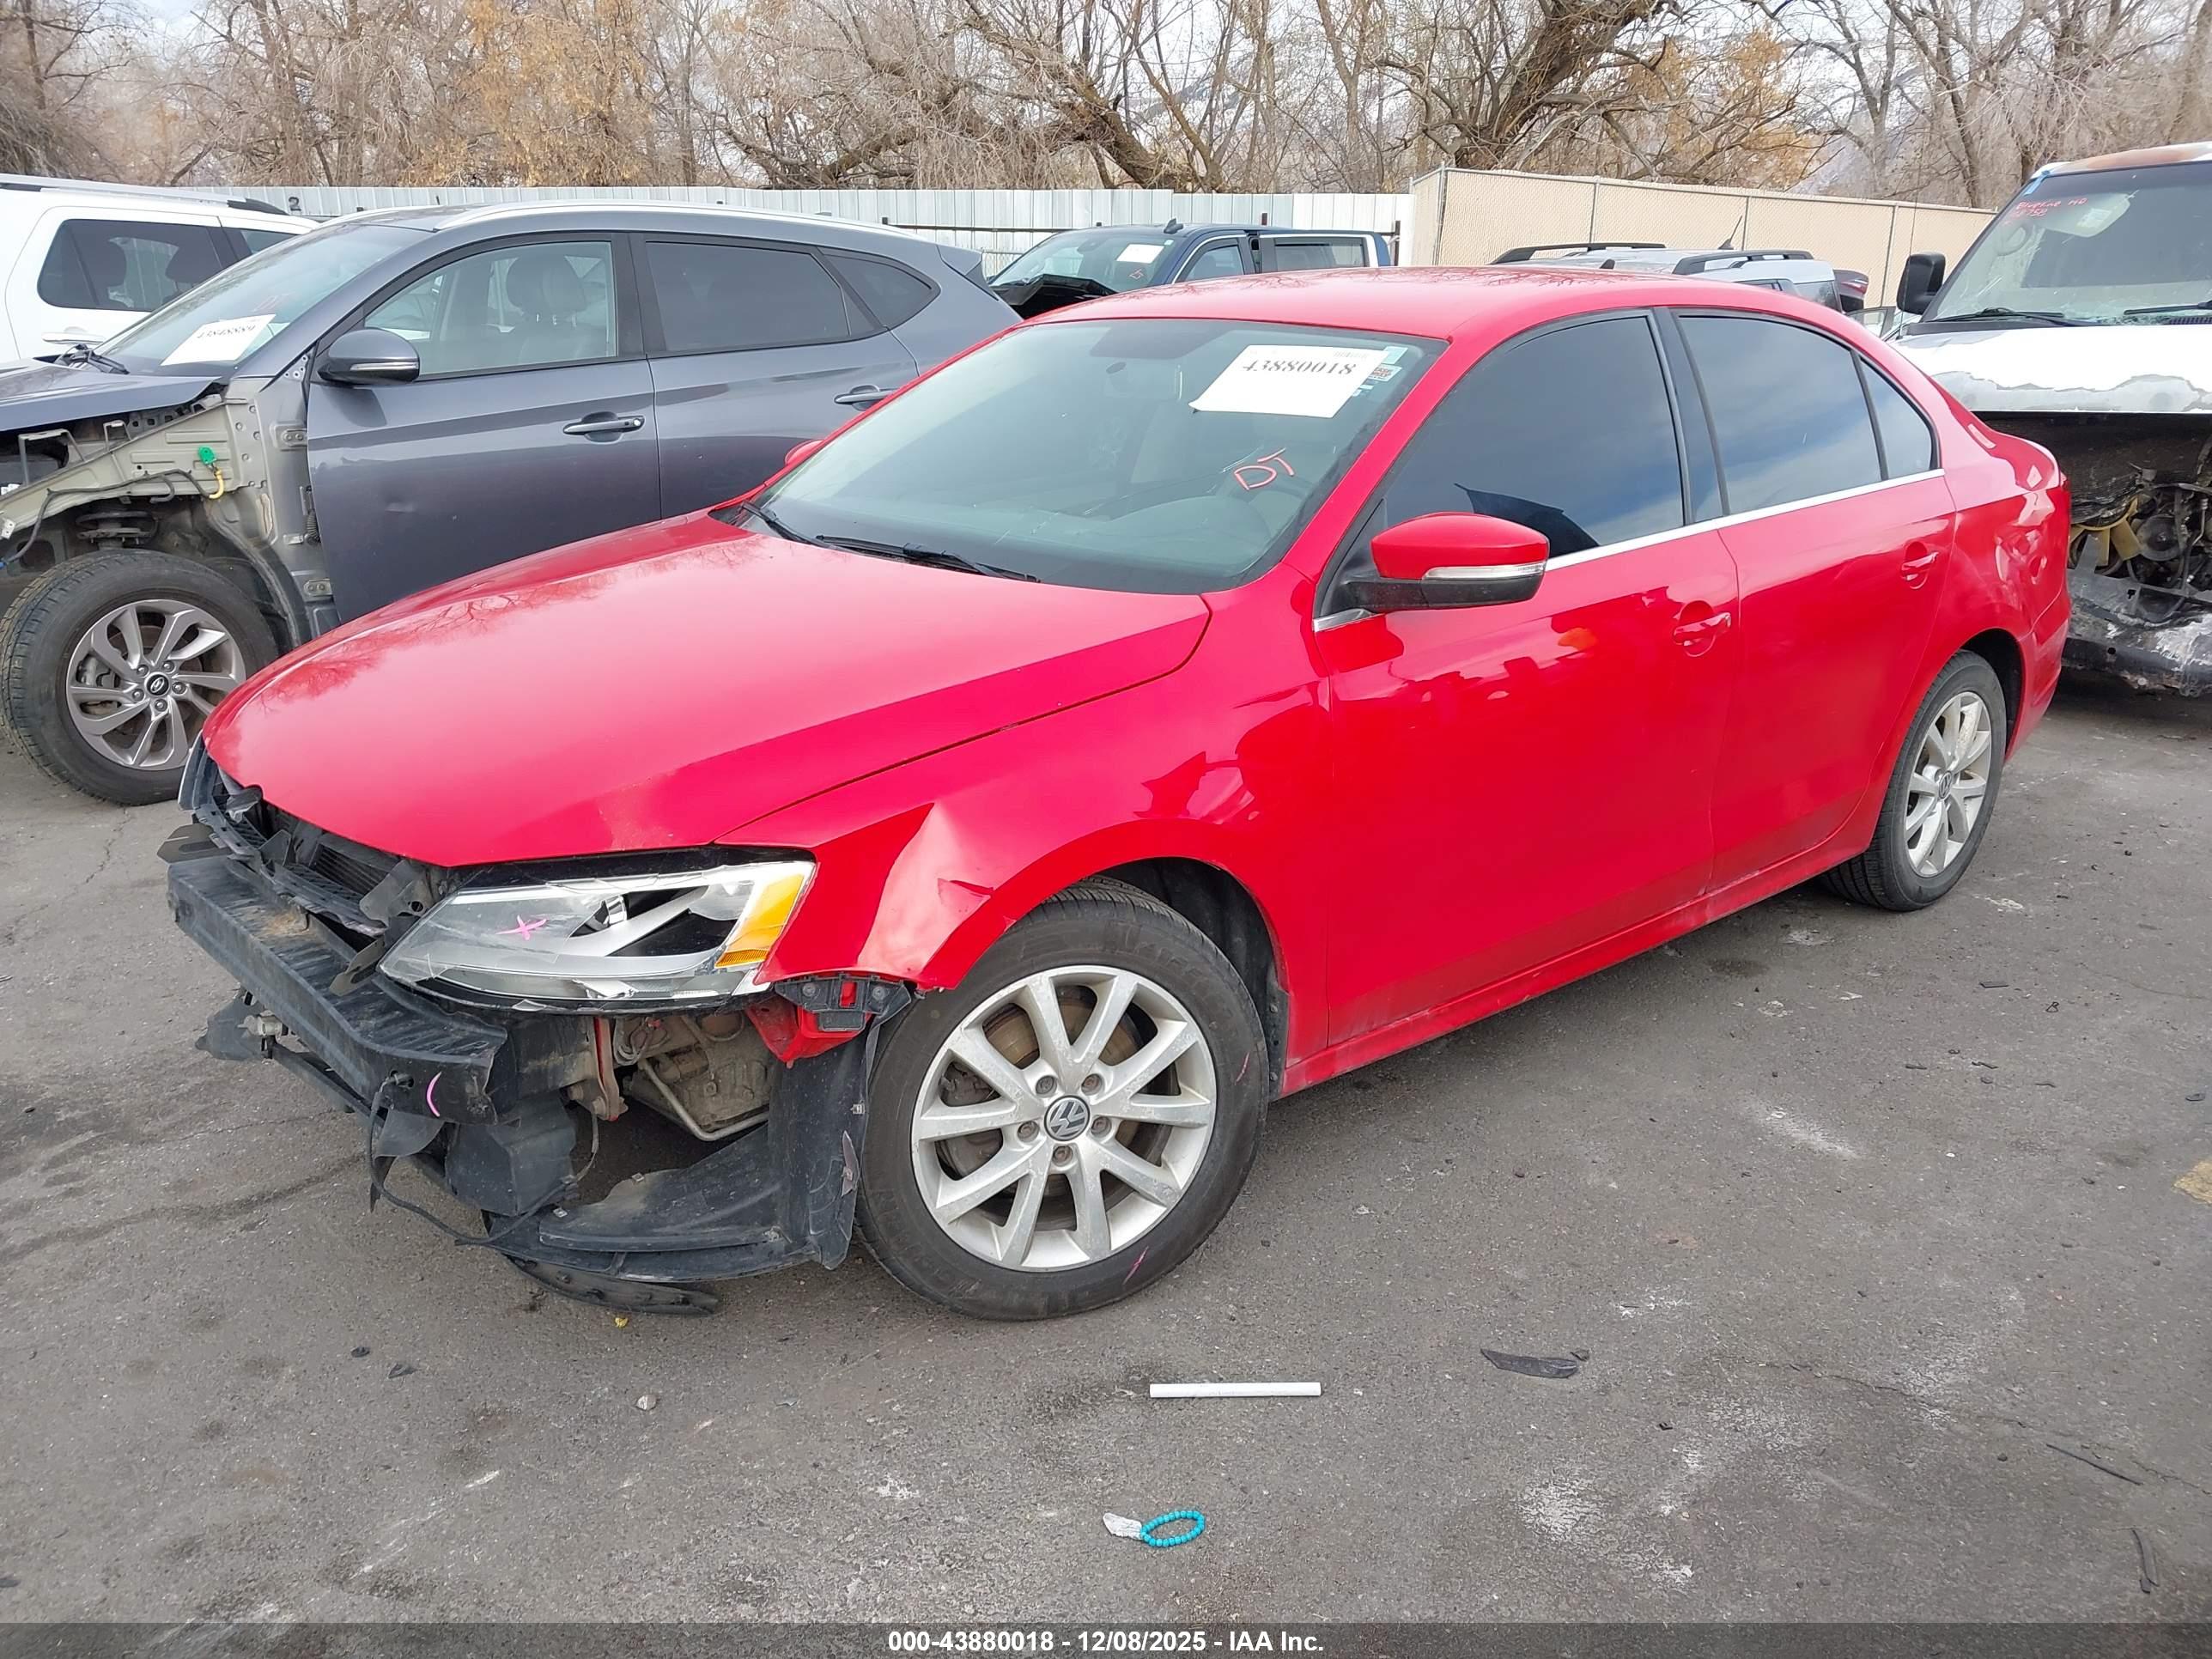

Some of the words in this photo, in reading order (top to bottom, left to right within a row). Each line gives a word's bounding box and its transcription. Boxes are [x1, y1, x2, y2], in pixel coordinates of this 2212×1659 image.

[289, 196, 302, 212] 2
[1243, 359, 1357, 375] 43880018
[1233, 447, 1296, 491] DT
